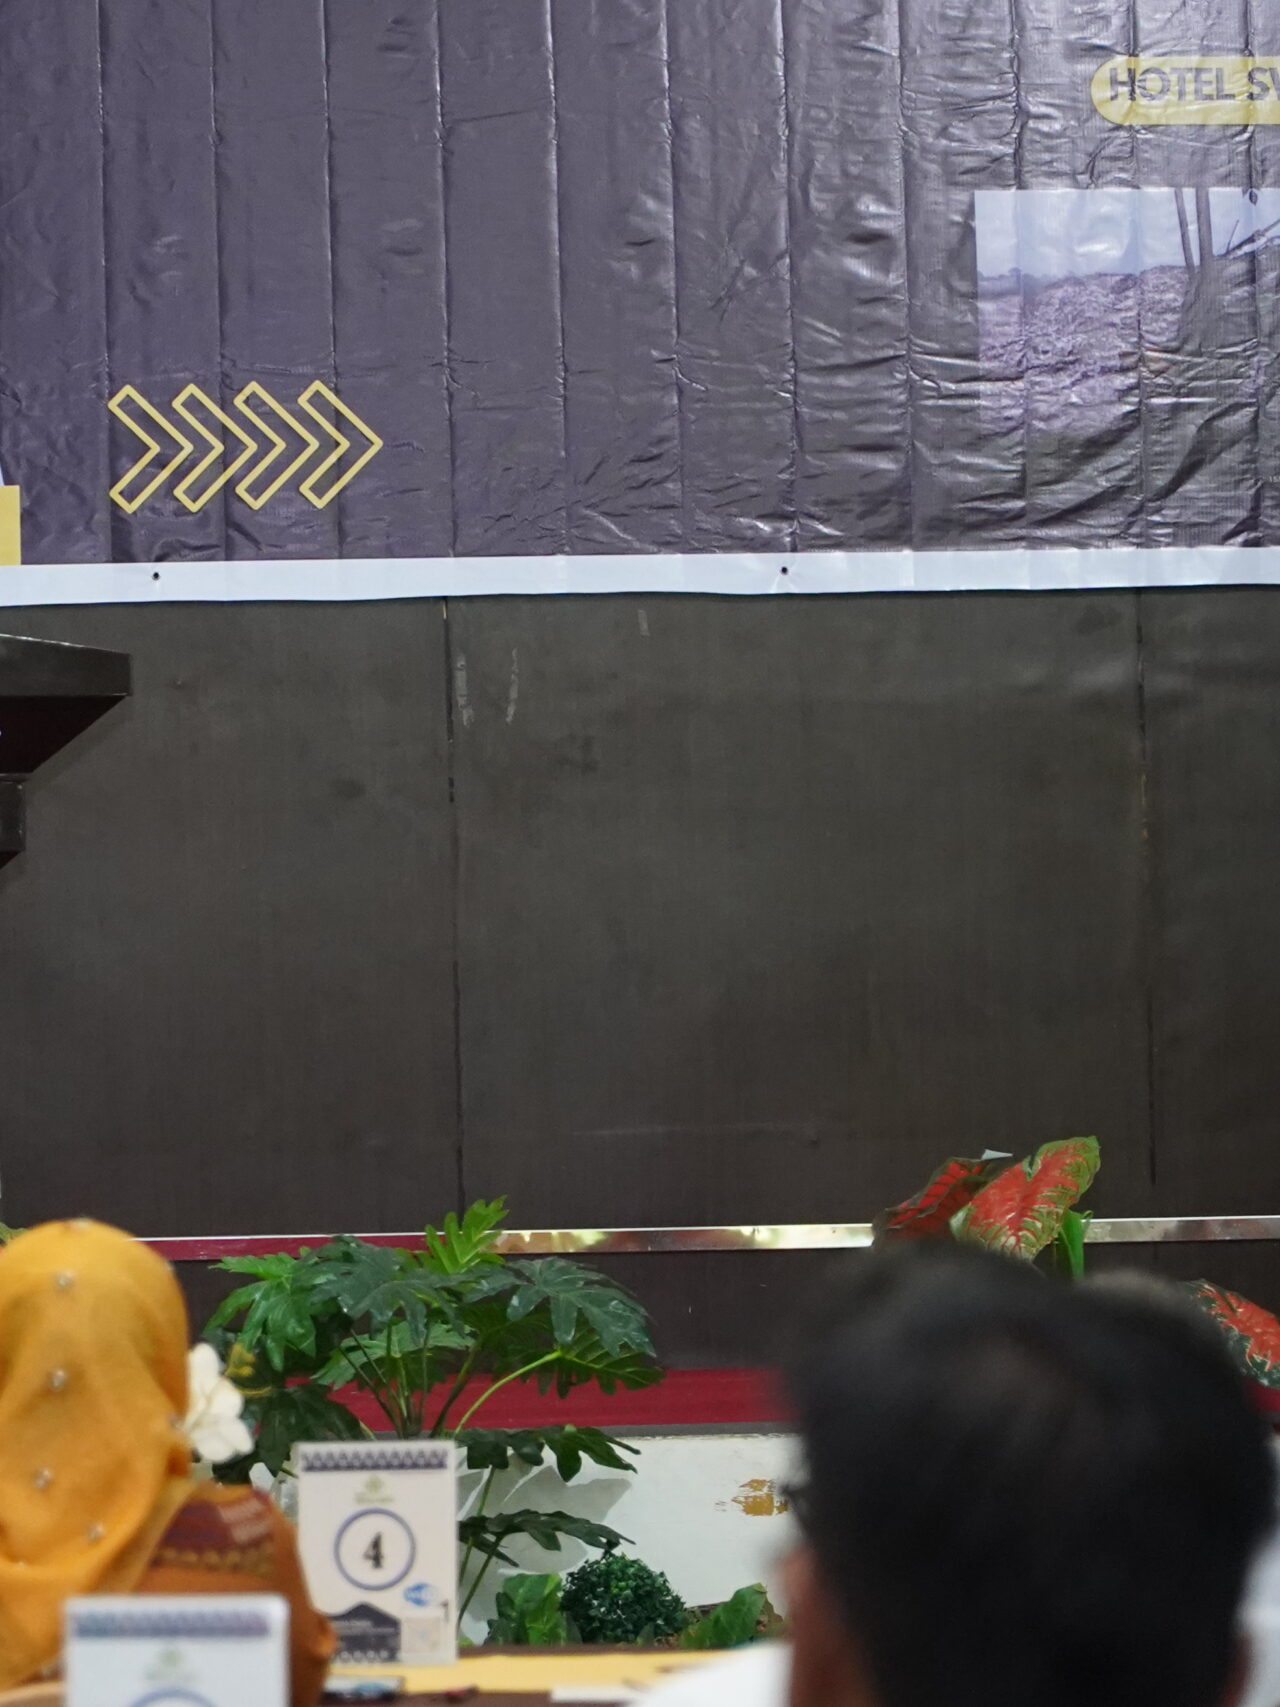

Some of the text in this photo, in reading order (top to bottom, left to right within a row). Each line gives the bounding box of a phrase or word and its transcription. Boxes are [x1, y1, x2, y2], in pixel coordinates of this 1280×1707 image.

[1109, 66, 1280, 101] HOTEL S
[363, 1531, 384, 1569] 4
